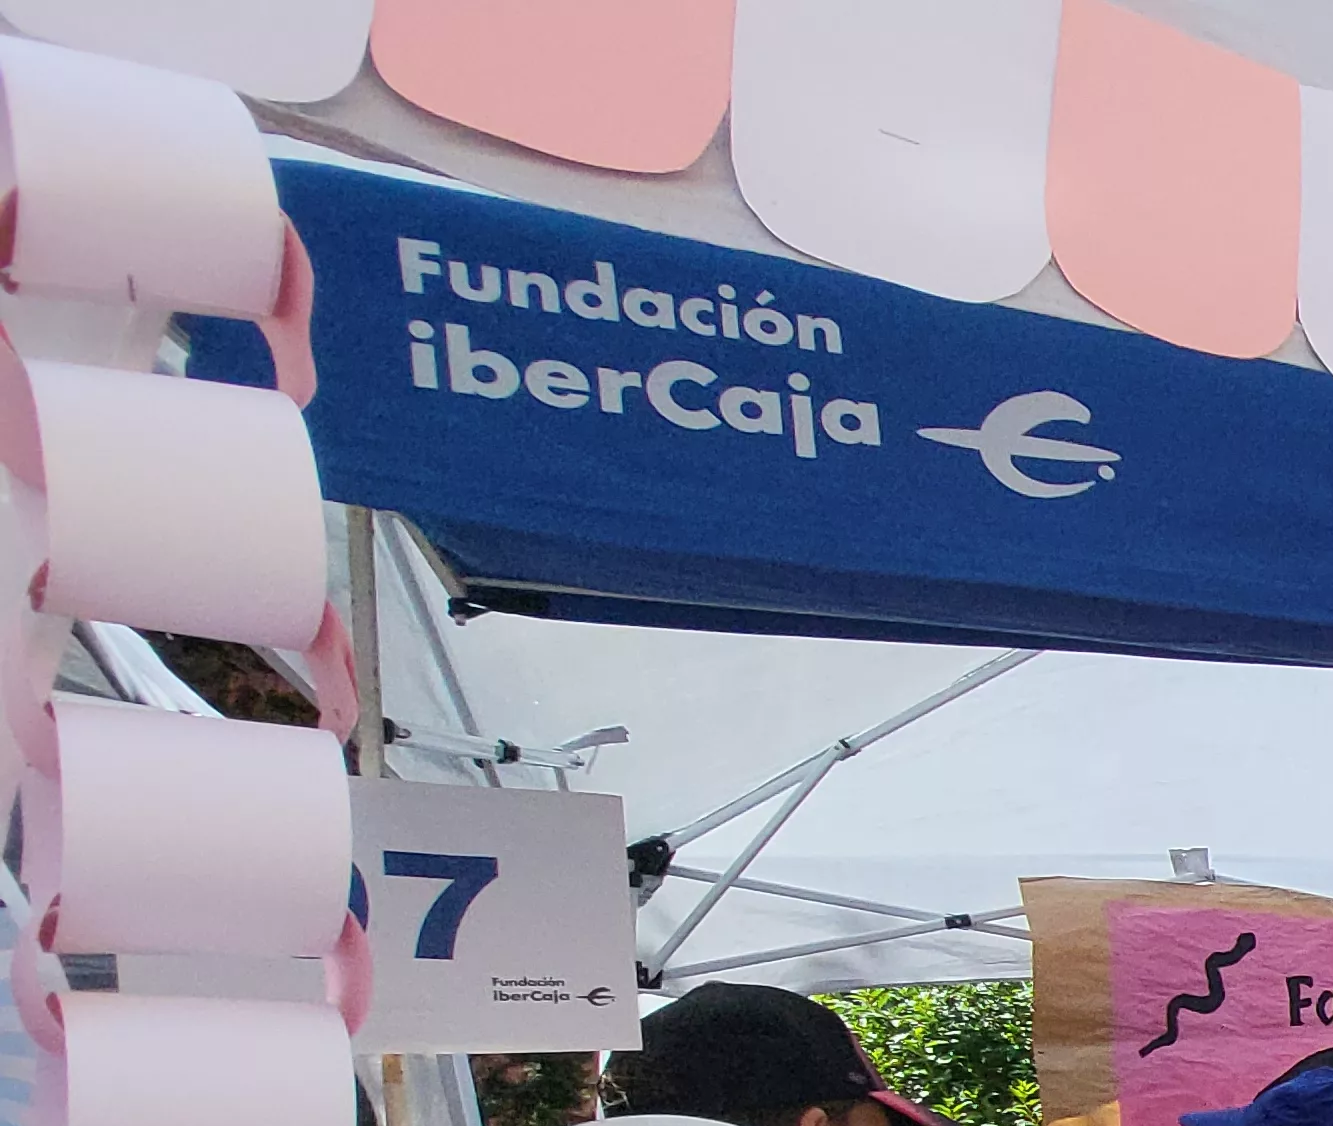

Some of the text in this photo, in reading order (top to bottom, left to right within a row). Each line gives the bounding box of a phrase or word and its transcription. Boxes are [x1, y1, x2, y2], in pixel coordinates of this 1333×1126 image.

[398, 237, 843, 354] Fundación
[408, 320, 882, 458] iberCaja
[348, 850, 499, 960] 7
